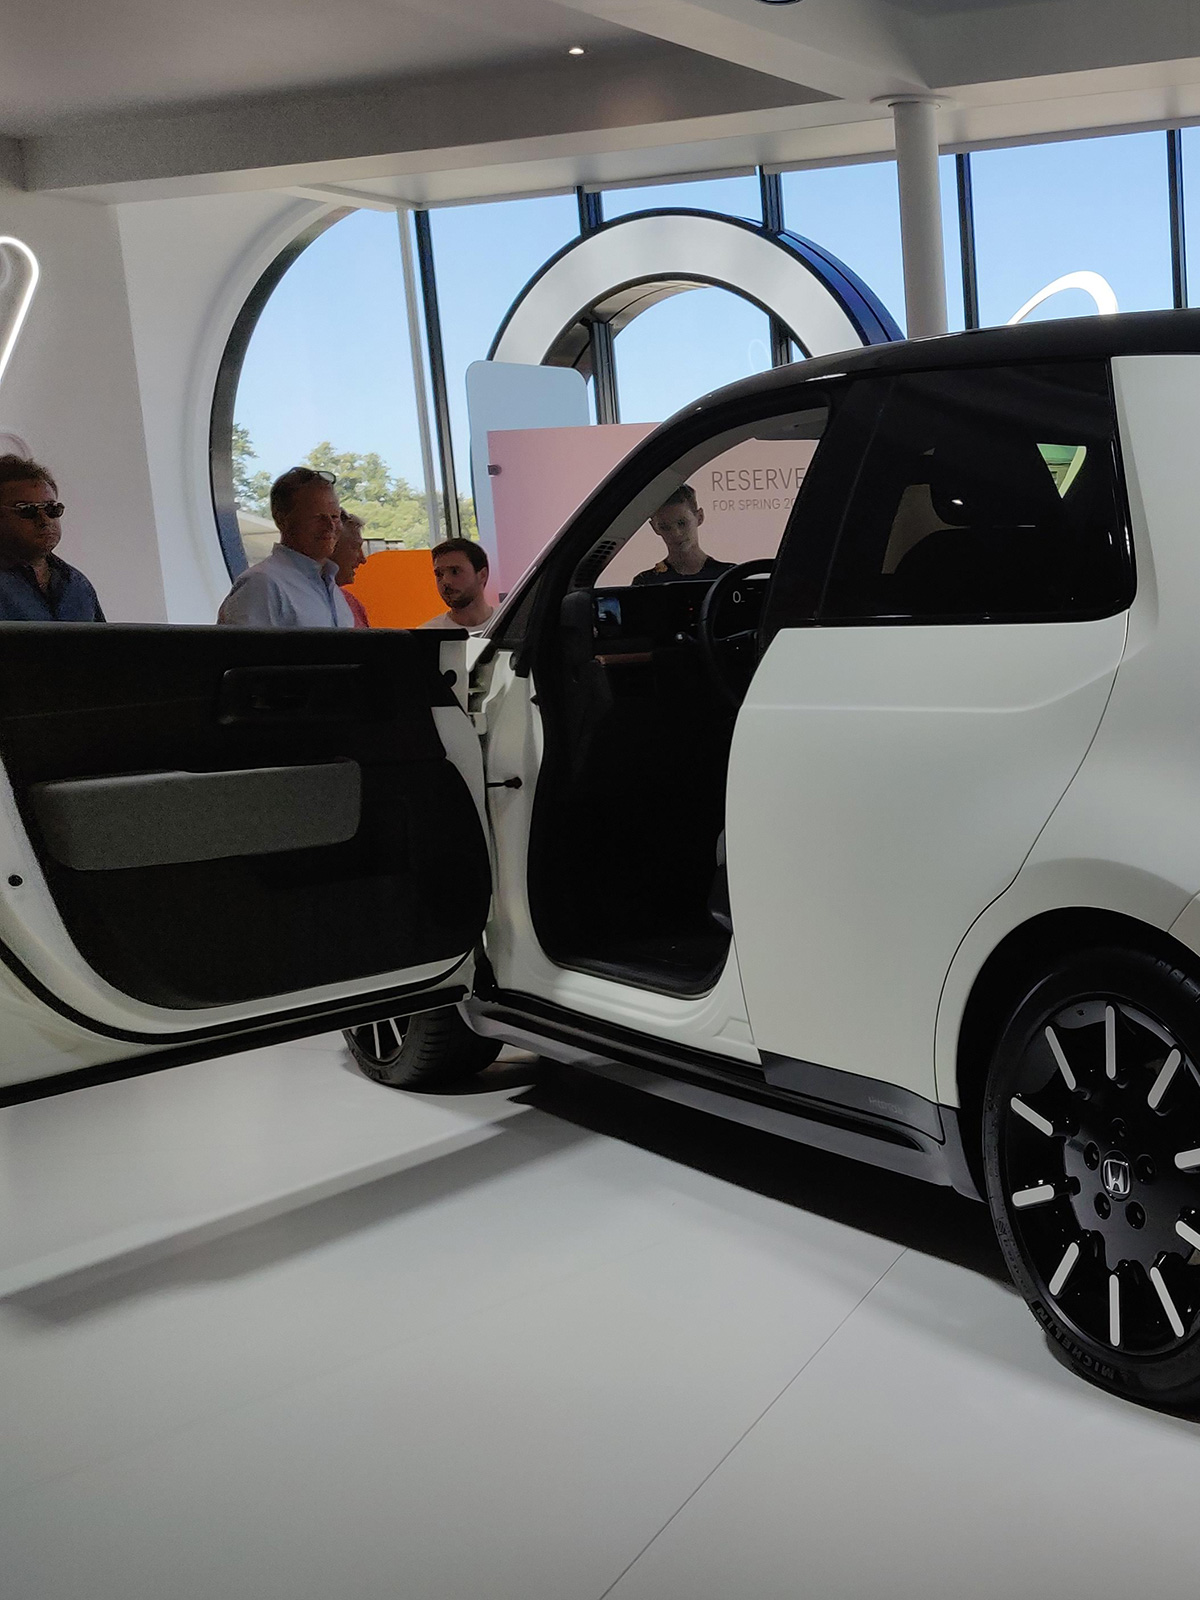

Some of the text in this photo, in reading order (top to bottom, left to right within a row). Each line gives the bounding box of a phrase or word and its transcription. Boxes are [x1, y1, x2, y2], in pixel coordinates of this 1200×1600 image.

[711, 467, 806, 492] RESERVE
[712, 501, 736, 511] FOR
[738, 498, 781, 511] SPRING
[1036, 1305, 1116, 1381] MICHELIN
